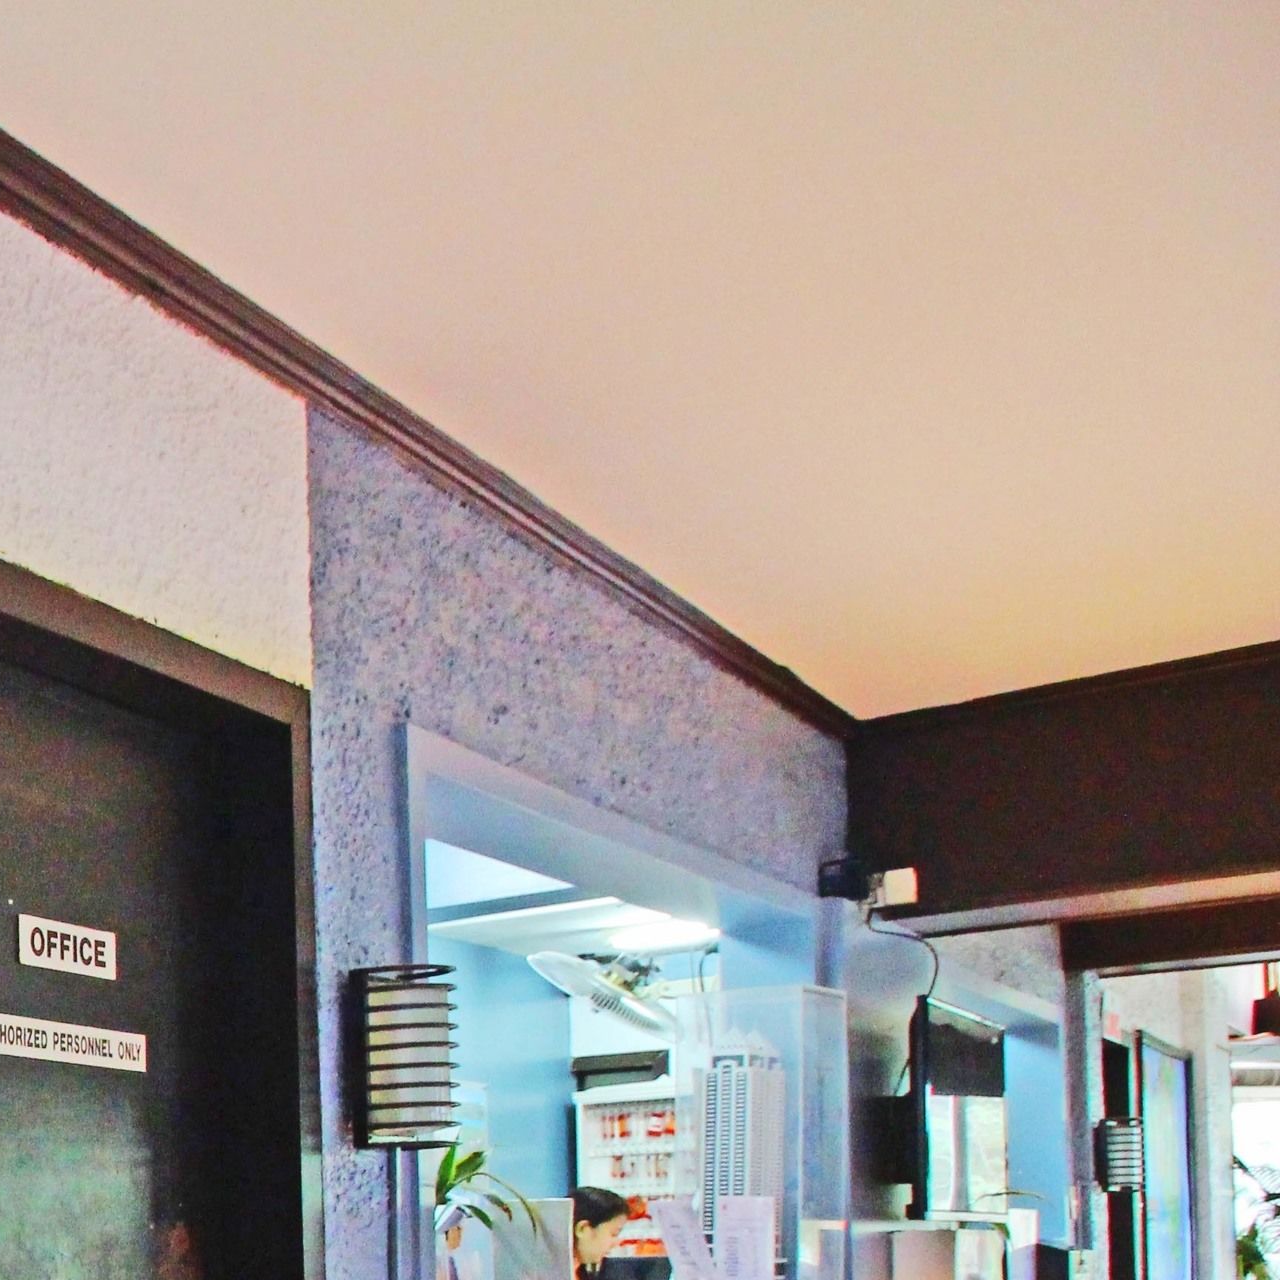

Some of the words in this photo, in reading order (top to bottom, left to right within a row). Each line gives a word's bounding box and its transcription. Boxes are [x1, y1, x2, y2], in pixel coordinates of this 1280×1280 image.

[30, 926, 106, 968] OFFICE
[53, 1032, 113, 1058] PERSONNEL
[118, 1042, 142, 1062] ONLY
